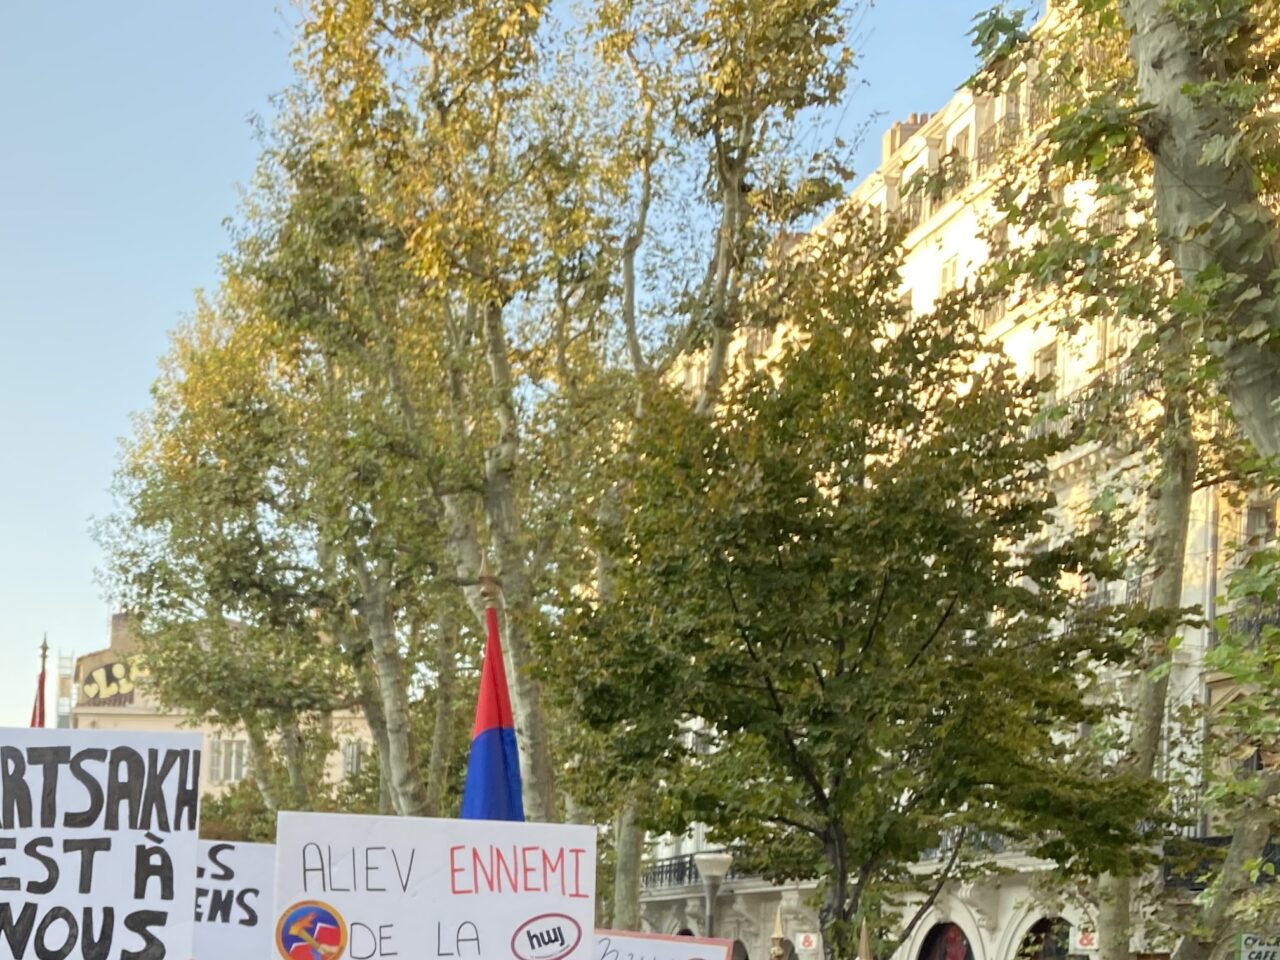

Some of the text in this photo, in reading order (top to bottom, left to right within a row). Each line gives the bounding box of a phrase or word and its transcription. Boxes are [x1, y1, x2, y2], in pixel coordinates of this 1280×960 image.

[133, 831, 175, 901] À
[302, 842, 590, 899] ALIEV ENNEMI
[349, 920, 482, 960] DE LA
